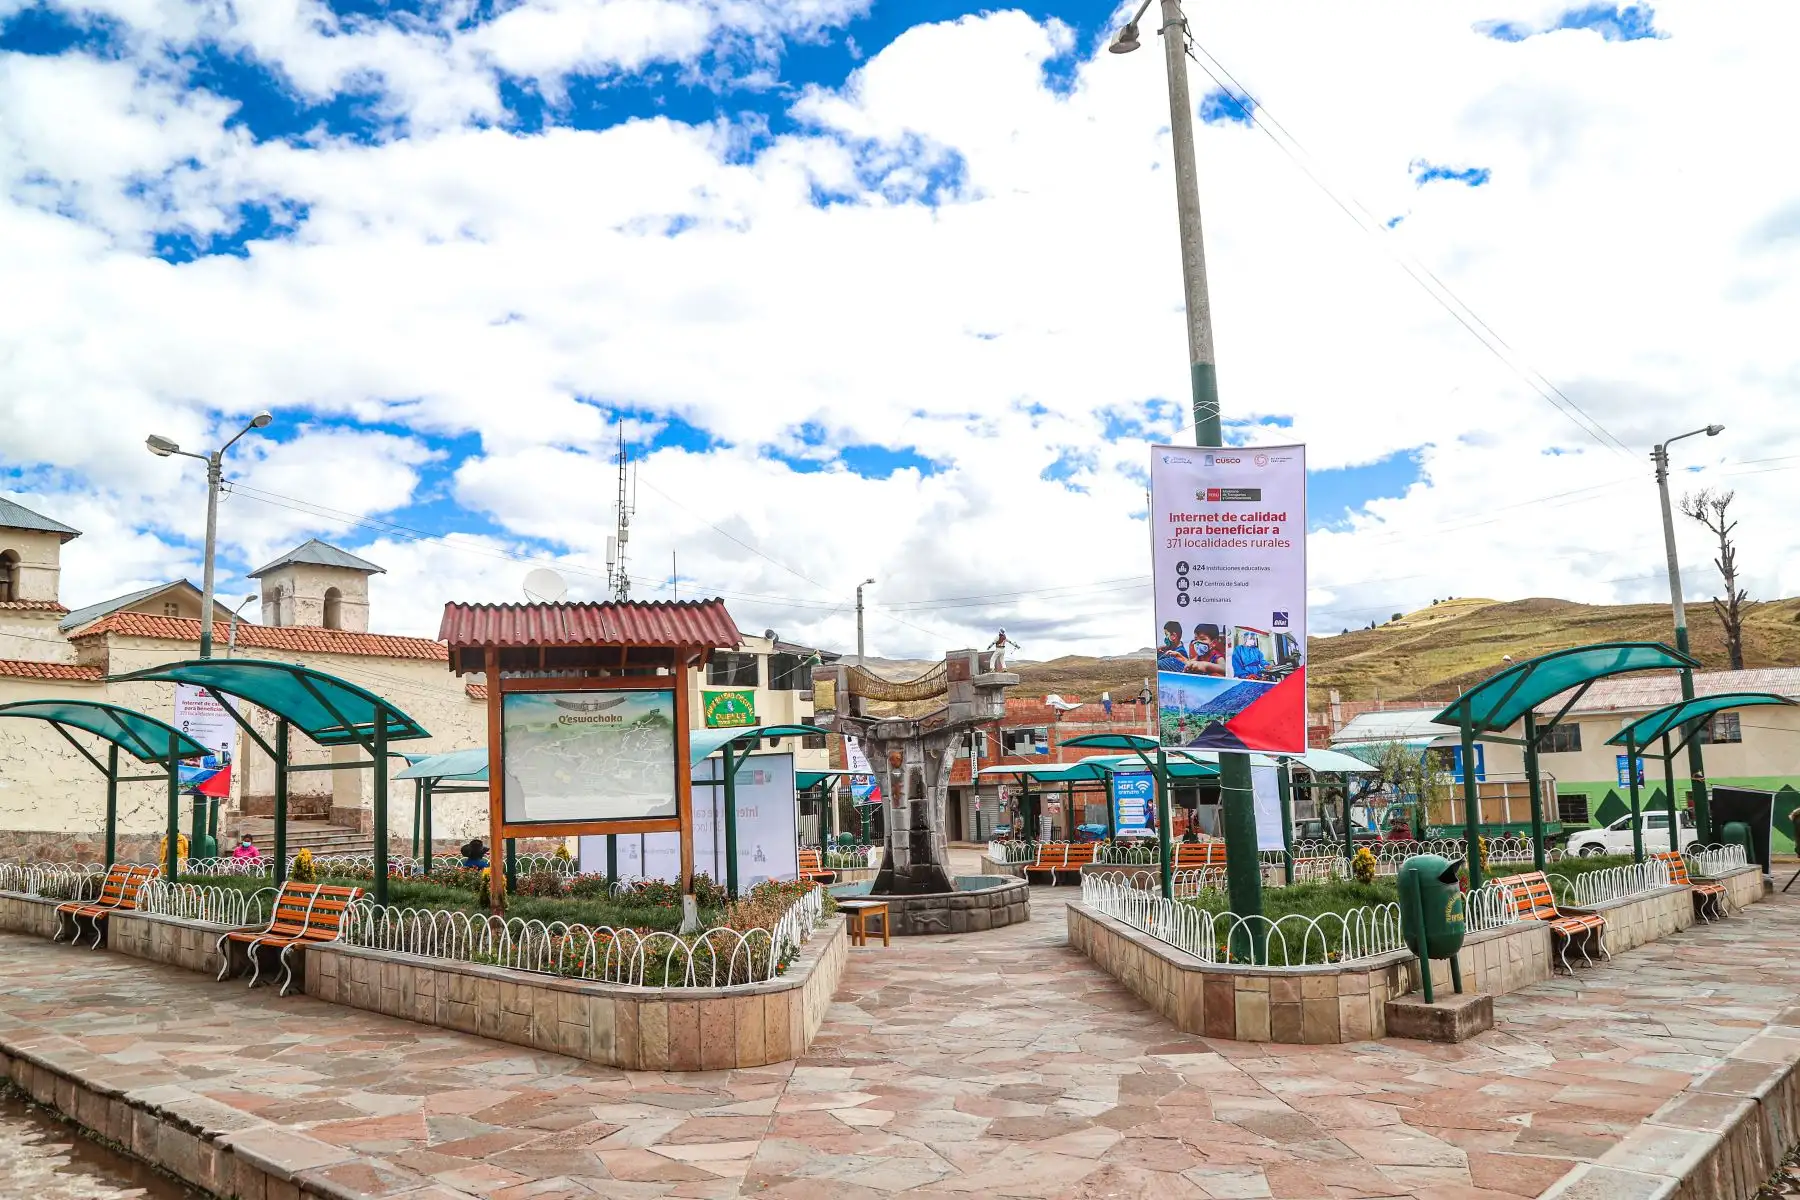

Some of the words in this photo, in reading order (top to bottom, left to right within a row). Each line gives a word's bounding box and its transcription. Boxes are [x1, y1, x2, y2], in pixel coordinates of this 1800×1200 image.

[1169, 512, 1219, 522] Internet
[1221, 512, 1237, 522] de
[1240, 511, 1286, 522] calidad
[1175, 526, 1202, 537] para
[1205, 524, 1269, 535] beneficiar
[1272, 526, 1280, 535] a
[1166, 538, 1181, 549] 371
[1184, 537, 1248, 548] localidades
[1251, 537, 1290, 548] rurales
